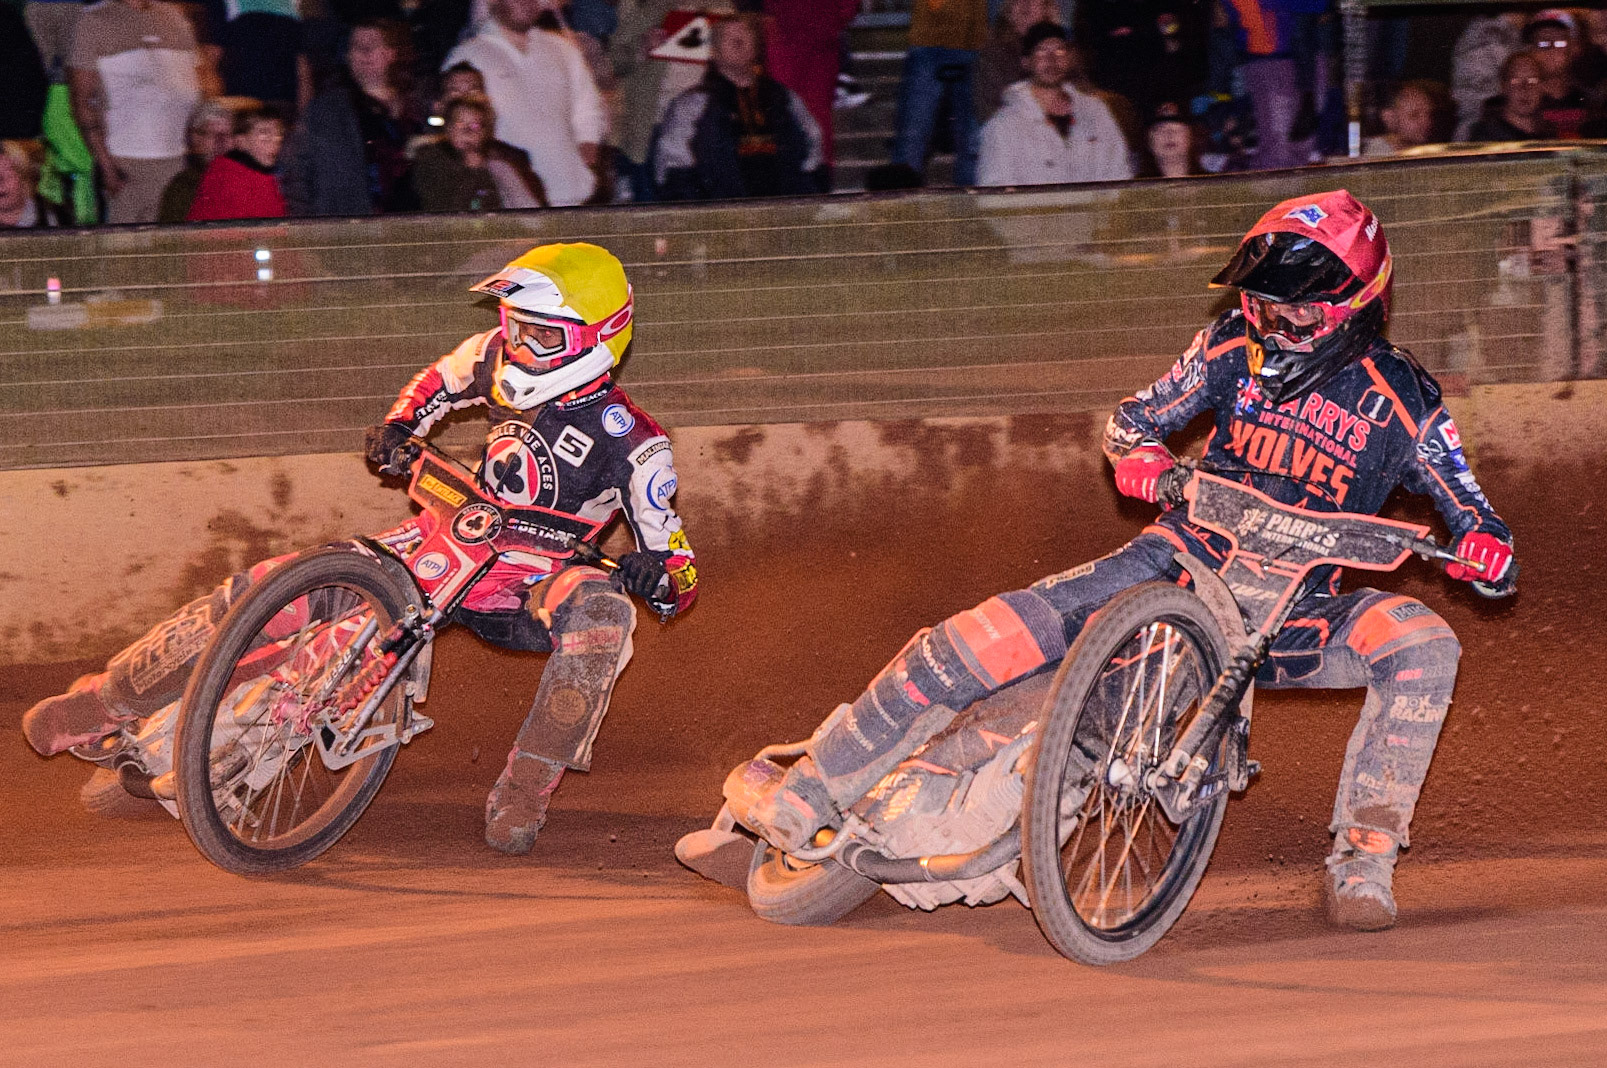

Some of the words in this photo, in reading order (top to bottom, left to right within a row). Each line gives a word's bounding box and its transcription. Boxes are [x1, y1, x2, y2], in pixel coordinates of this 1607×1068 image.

[609, 411, 628, 429] ATPI
[1368, 394, 1386, 420] 1
[1263, 392, 1371, 452] ARRYS
[559, 432, 588, 458] 5
[520, 427, 541, 451] VUE
[537, 456, 553, 491] ACES
[657, 477, 677, 501] ATPI
[422, 559, 442, 572] ATPI
